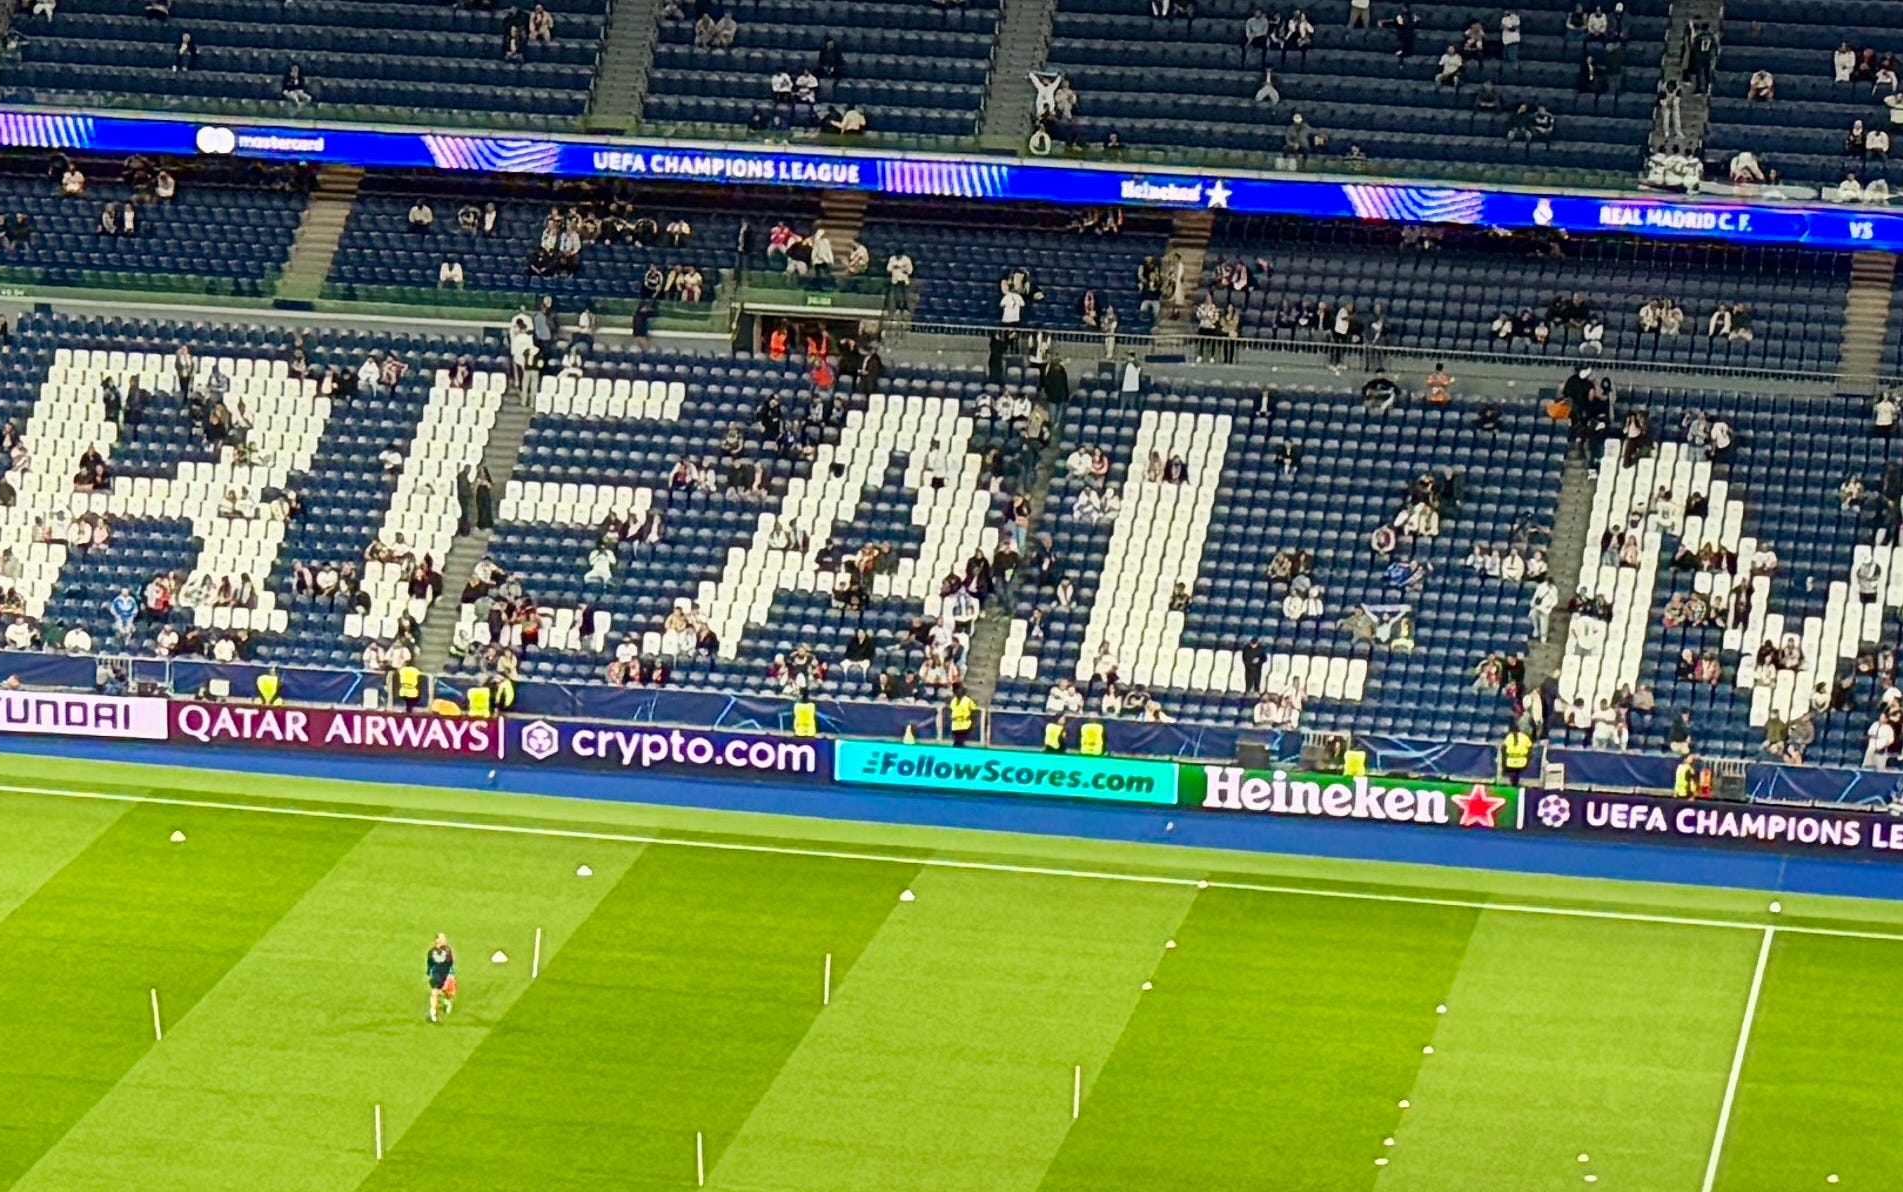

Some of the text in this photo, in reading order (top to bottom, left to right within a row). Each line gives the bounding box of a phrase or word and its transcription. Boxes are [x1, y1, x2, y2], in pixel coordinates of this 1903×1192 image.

[593, 150, 861, 185] UEFA CHAMPIONS LEAGUE
[1599, 205, 1642, 227] REAL
[1645, 208, 1716, 231] MADRID
[1718, 212, 1737, 232] C.
[1849, 221, 1874, 241] VS
[177, 704, 491, 753] QATAR AIRWAYS
[572, 728, 816, 774] crypto.com
[879, 751, 1156, 796] FollowScores.com
[1203, 765, 1449, 825] Heineken
[1586, 801, 1666, 833] UEFA
[1675, 808, 1860, 848] CHAMPIONS
